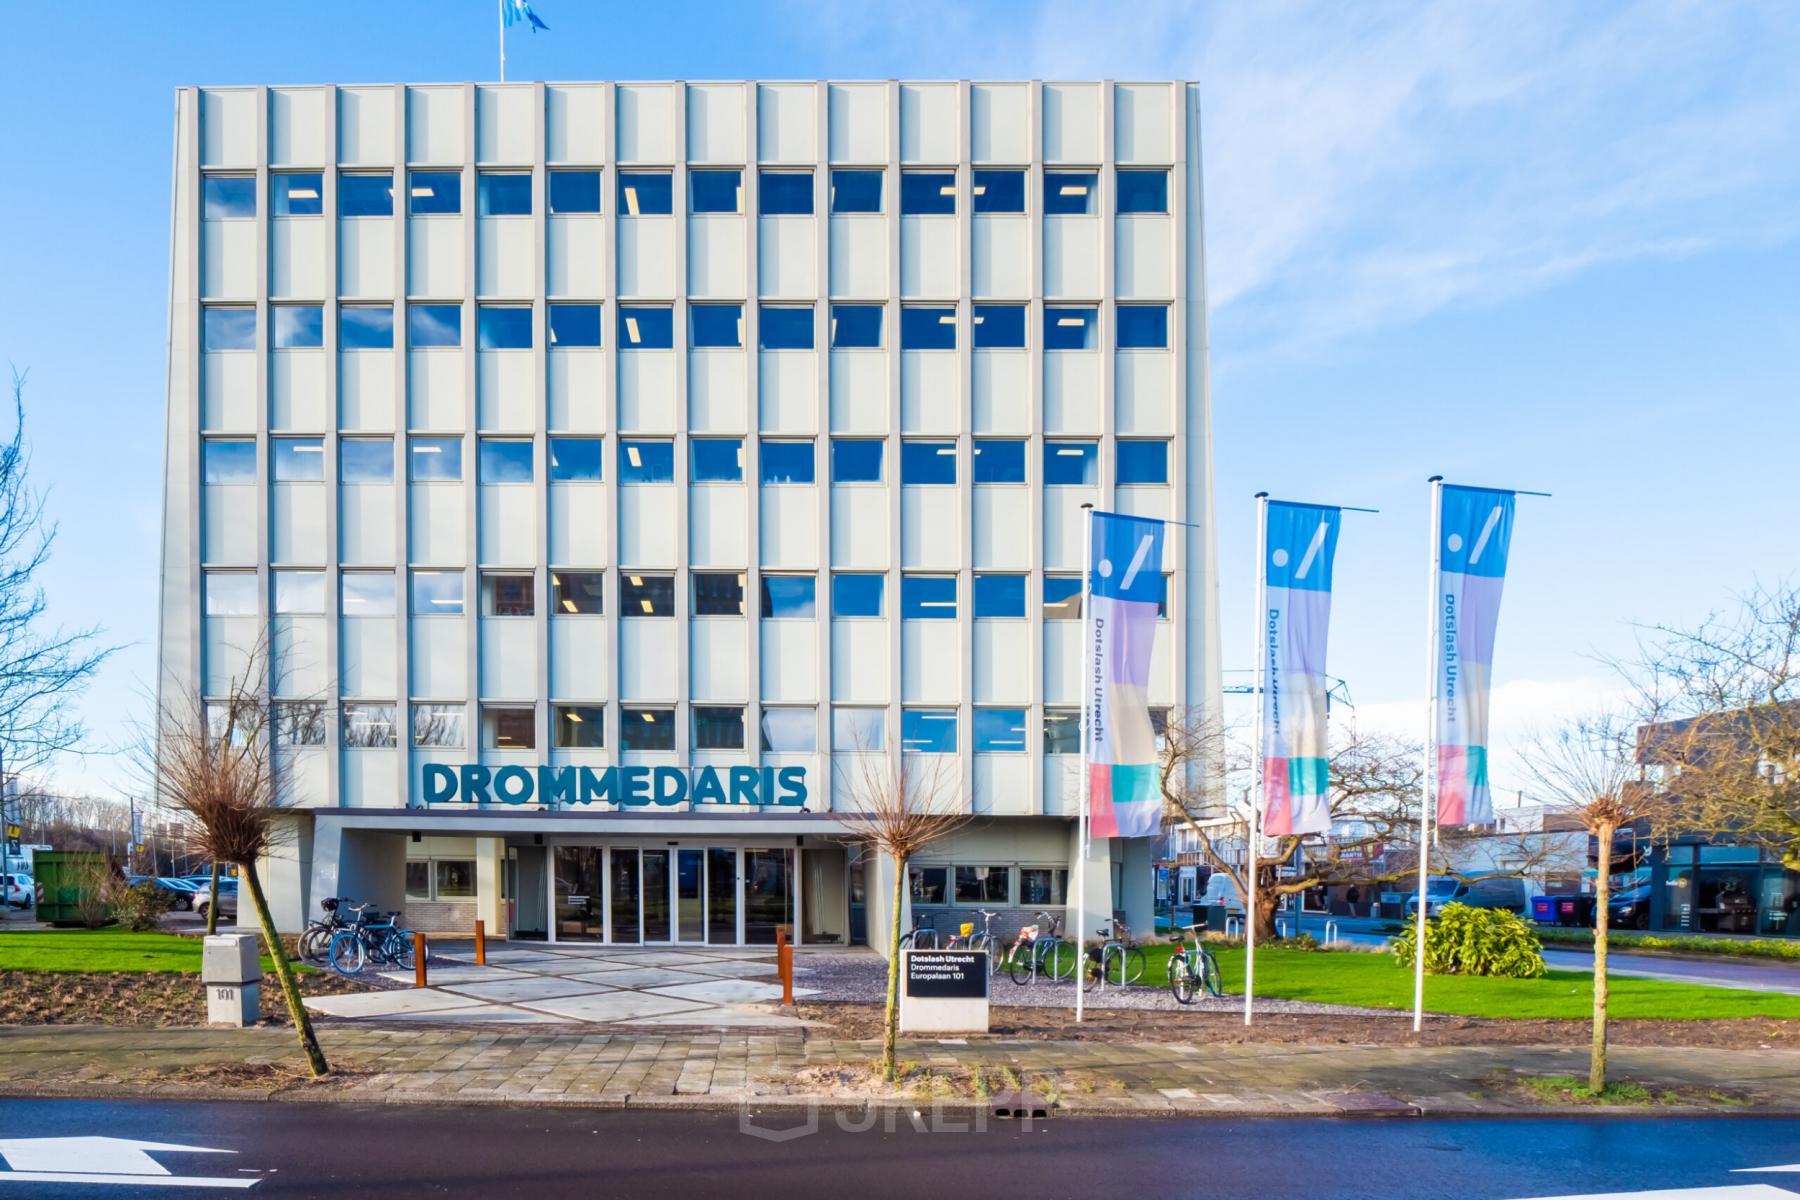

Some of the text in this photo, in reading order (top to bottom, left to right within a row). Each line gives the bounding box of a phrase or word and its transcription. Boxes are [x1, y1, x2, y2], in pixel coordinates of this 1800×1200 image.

[1445, 594, 1457, 722] Dotslash Utrecht
[1094, 618, 1105, 742] Dotslash Utrecht
[422, 763, 808, 806] DROMMEDARIS
[910, 955, 975, 963] Dotslash Utrecht
[910, 972, 965, 980] Europalaan 101
[216, 988, 235, 1001] 101
